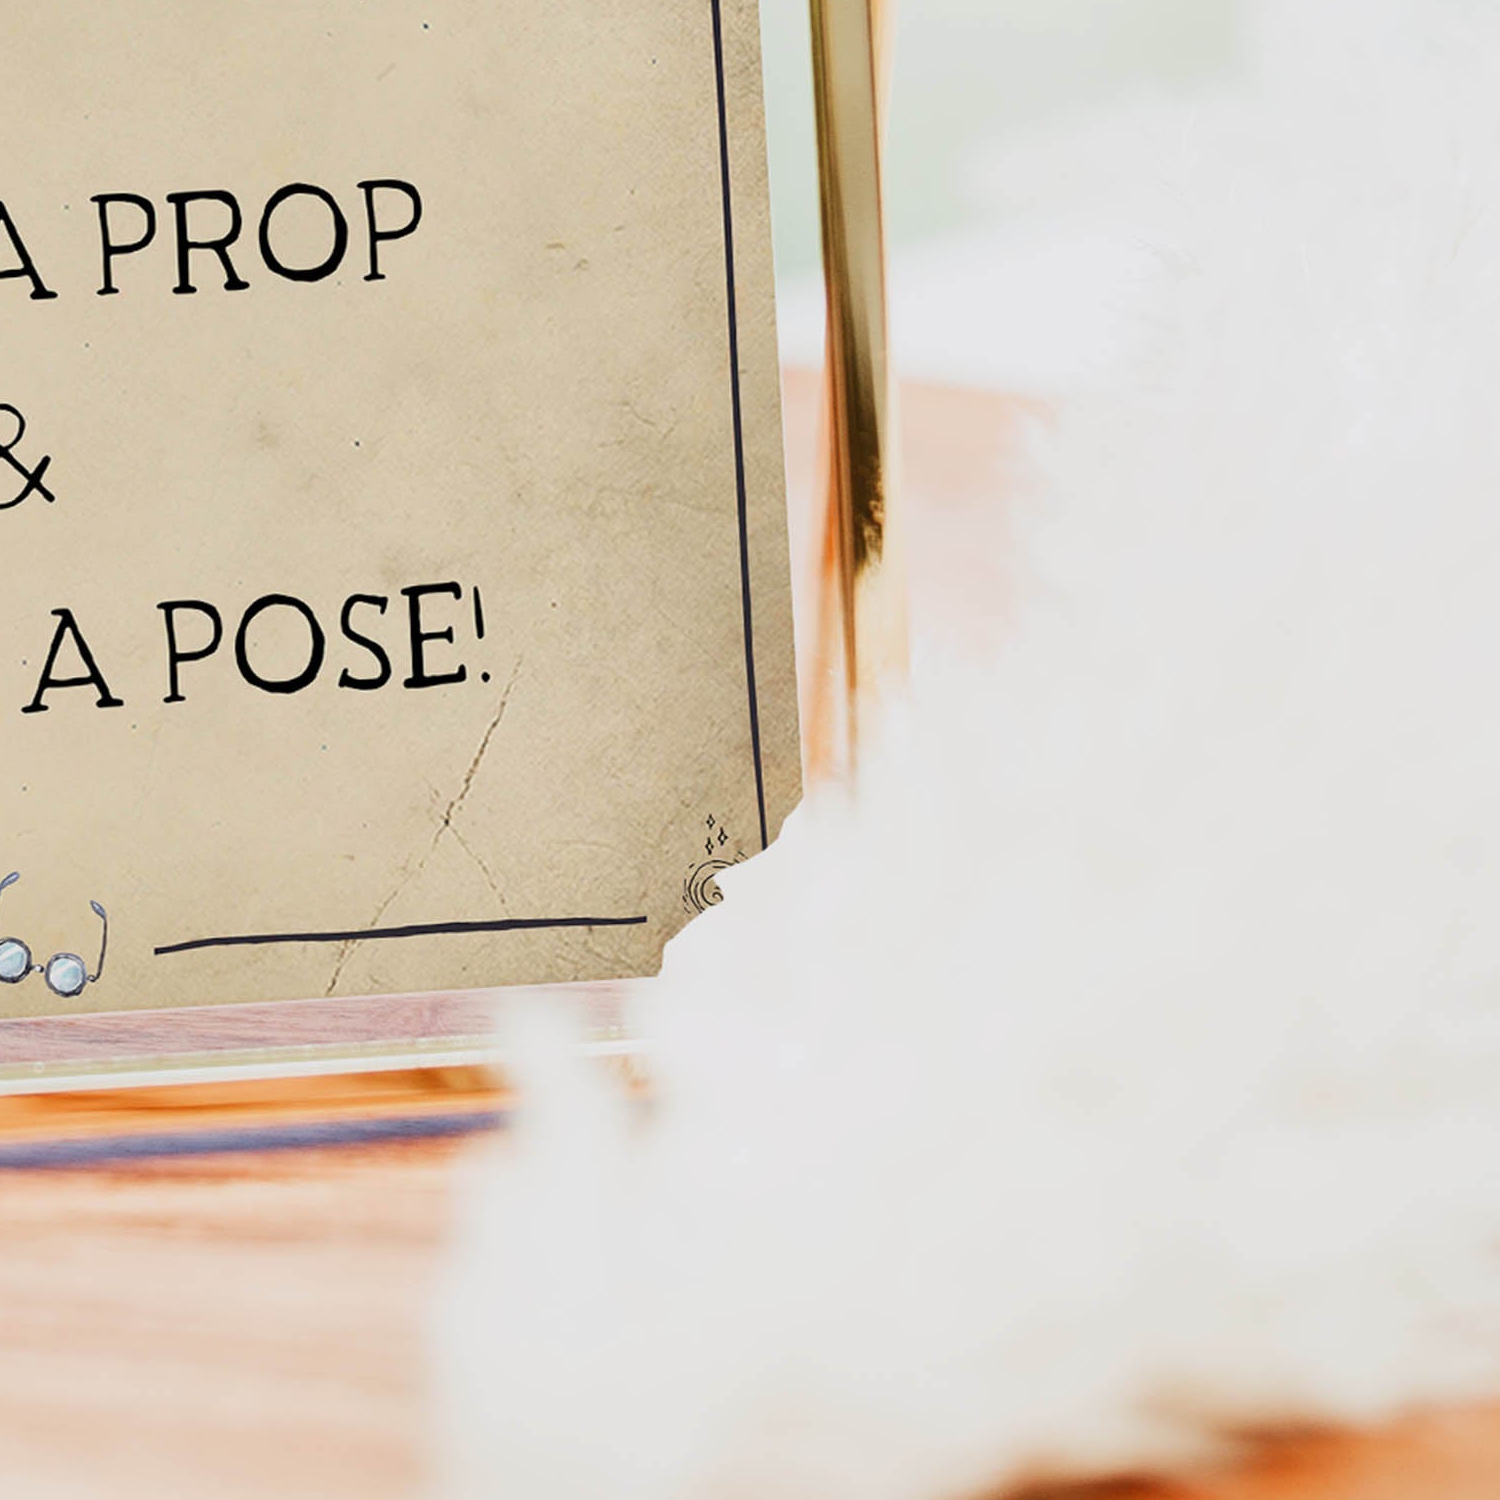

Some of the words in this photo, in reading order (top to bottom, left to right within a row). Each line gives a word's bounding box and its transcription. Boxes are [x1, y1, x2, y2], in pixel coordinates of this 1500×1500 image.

[89, 179, 422, 296] PROP
[21, 608, 124, 714] A
[156, 581, 493, 704] POSE!
